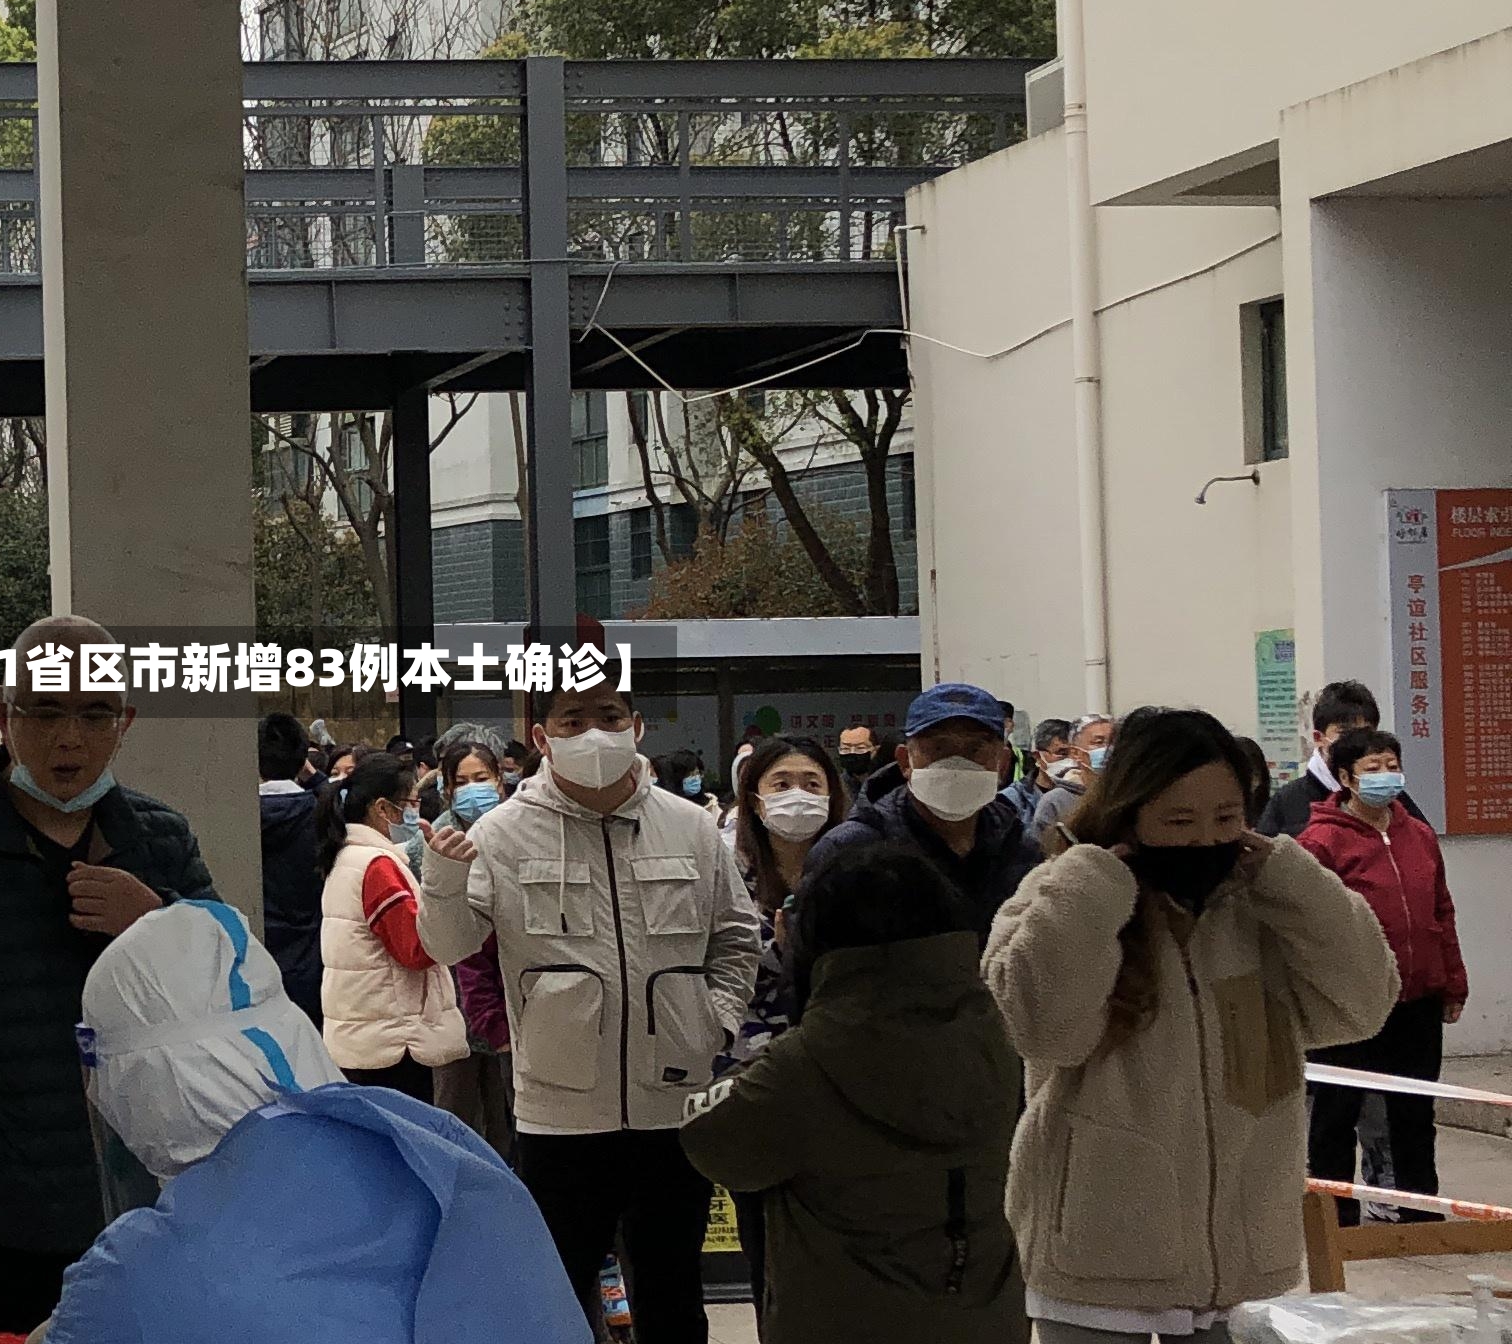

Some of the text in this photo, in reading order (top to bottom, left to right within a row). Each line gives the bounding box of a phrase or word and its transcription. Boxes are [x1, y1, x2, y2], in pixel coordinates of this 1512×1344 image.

[1407, 574, 1431, 739] 亭谊社区服务站
